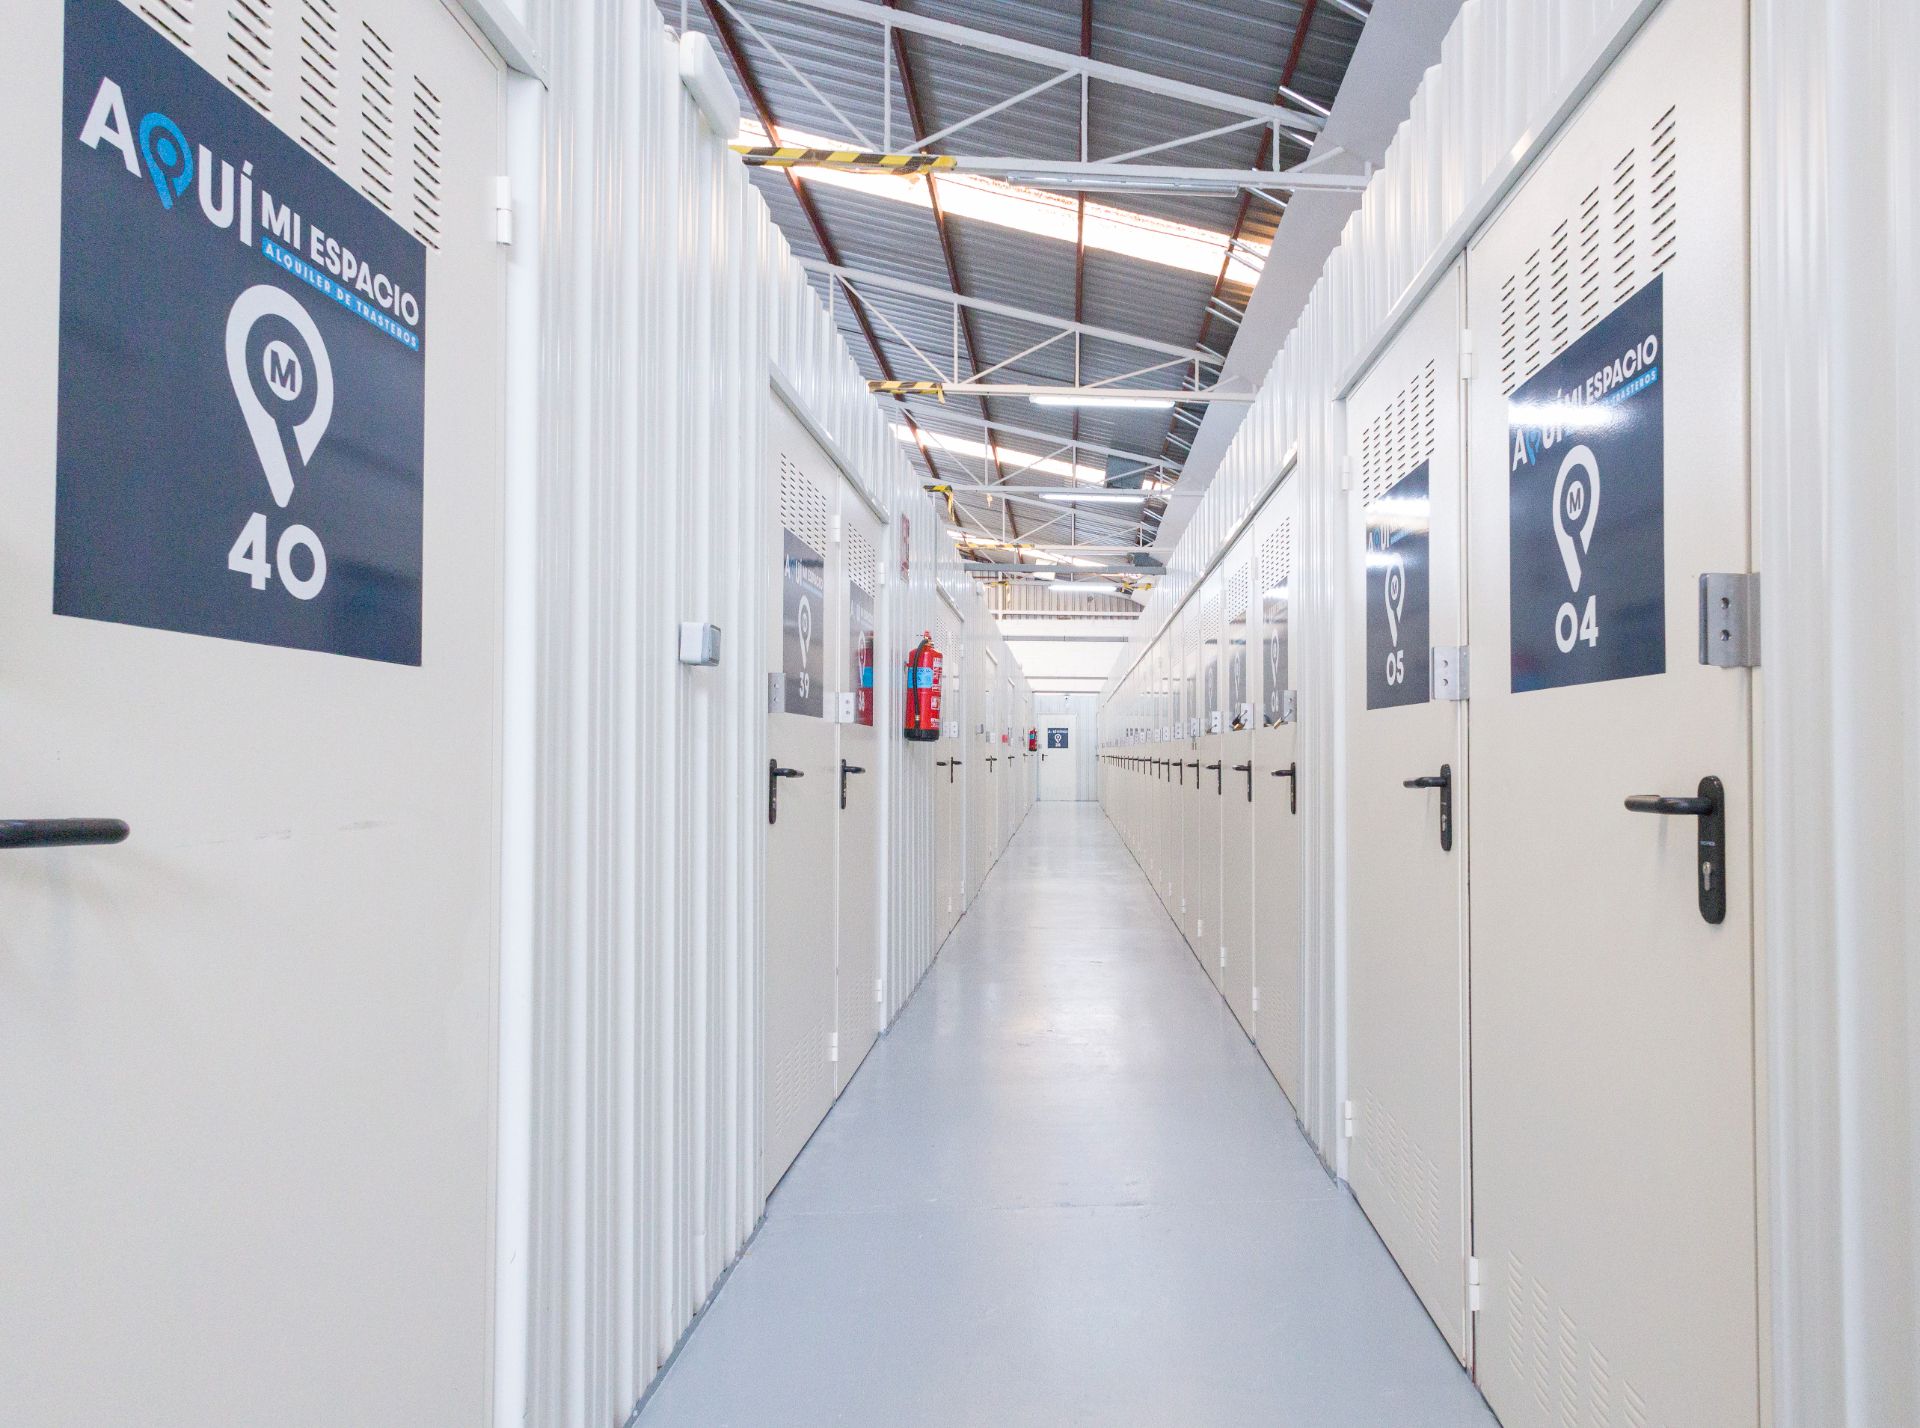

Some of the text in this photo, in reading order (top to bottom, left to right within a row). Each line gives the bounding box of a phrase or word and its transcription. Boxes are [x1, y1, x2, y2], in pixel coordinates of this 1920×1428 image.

[261, 189, 301, 251] MI
[310, 223, 420, 326] ESPACIO
[265, 243, 417, 348] ALQUILER DE TRASTEROS
[270, 348, 297, 394] M
[1585, 334, 1658, 404] ESPACIO
[1569, 487, 1582, 515] M
[228, 511, 328, 601] 40
[1554, 594, 1600, 654] 04
[799, 671, 811, 699] 39
[1386, 649, 1405, 687] 05
